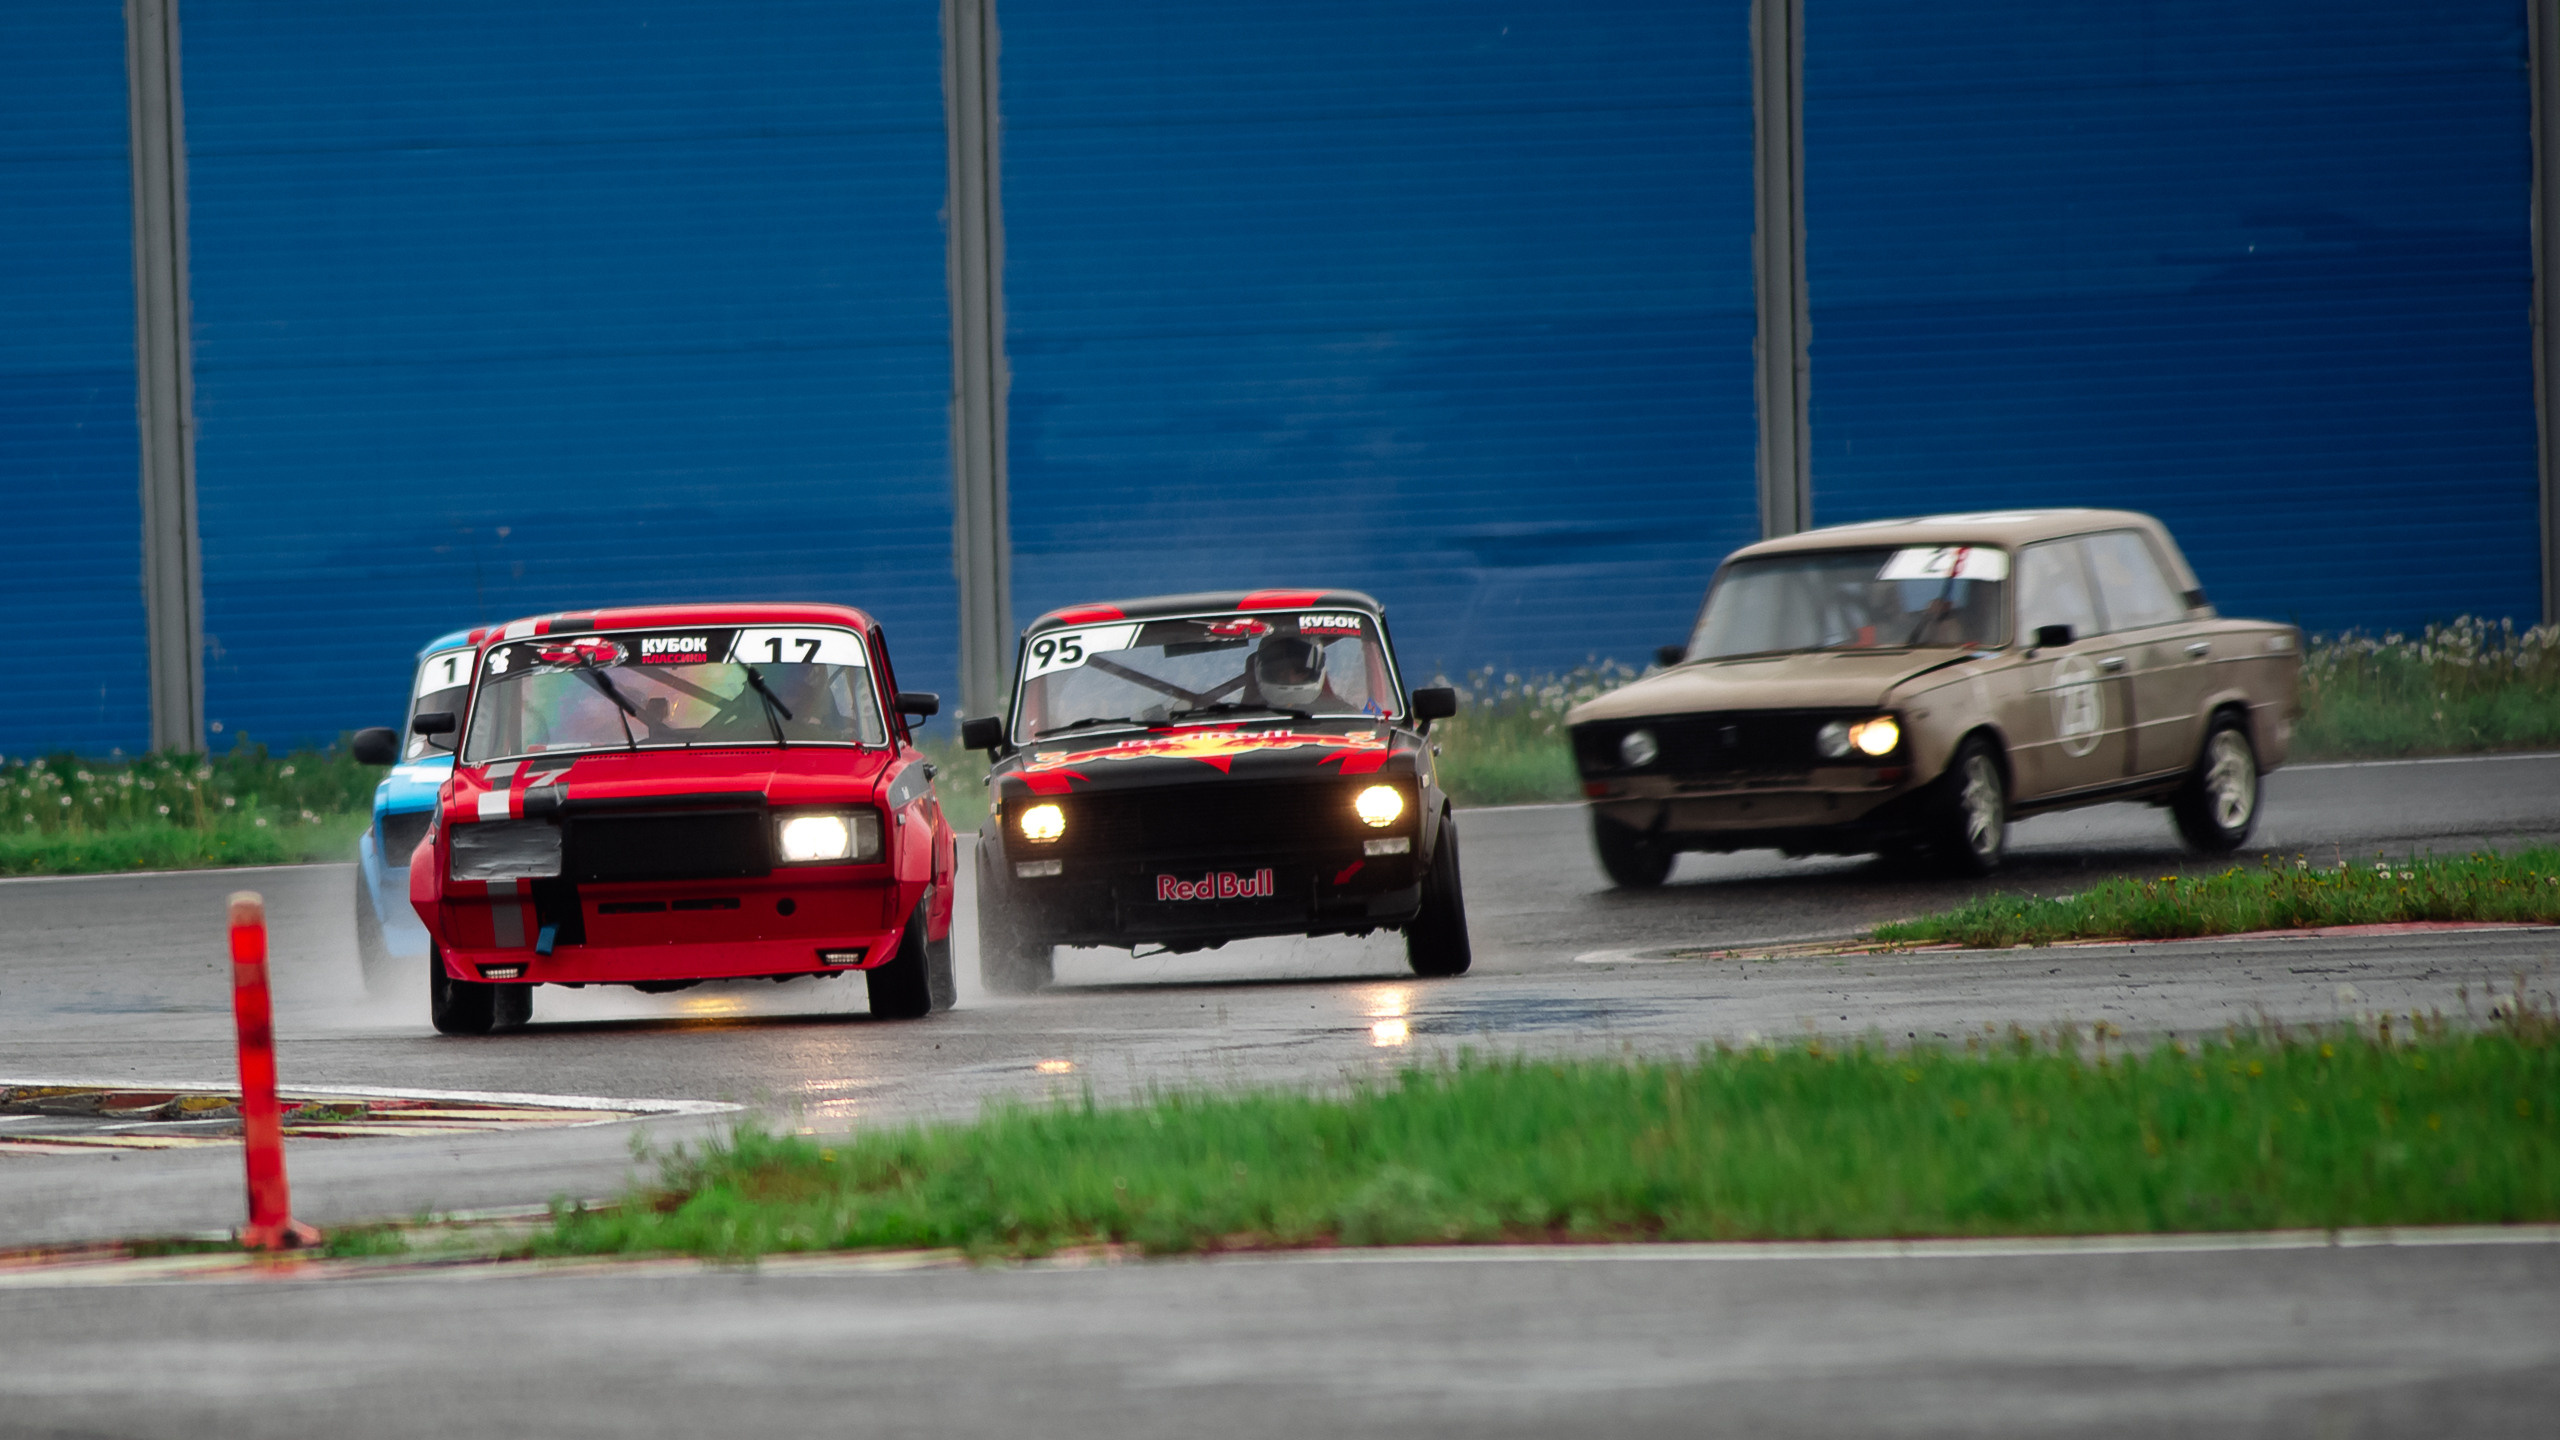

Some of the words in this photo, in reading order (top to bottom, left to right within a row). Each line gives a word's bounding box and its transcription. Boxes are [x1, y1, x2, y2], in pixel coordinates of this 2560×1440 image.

[1299, 615, 1361, 629] КУБОК
[642, 637, 707, 653] КУБОК
[765, 637, 821, 664] 17
[1033, 635, 1083, 669] 95
[444, 657, 457, 683] 1
[642, 653, 707, 664] КЛАССИКИ
[1157, 871, 1215, 900] Red
[1218, 868, 1273, 898] Bull
